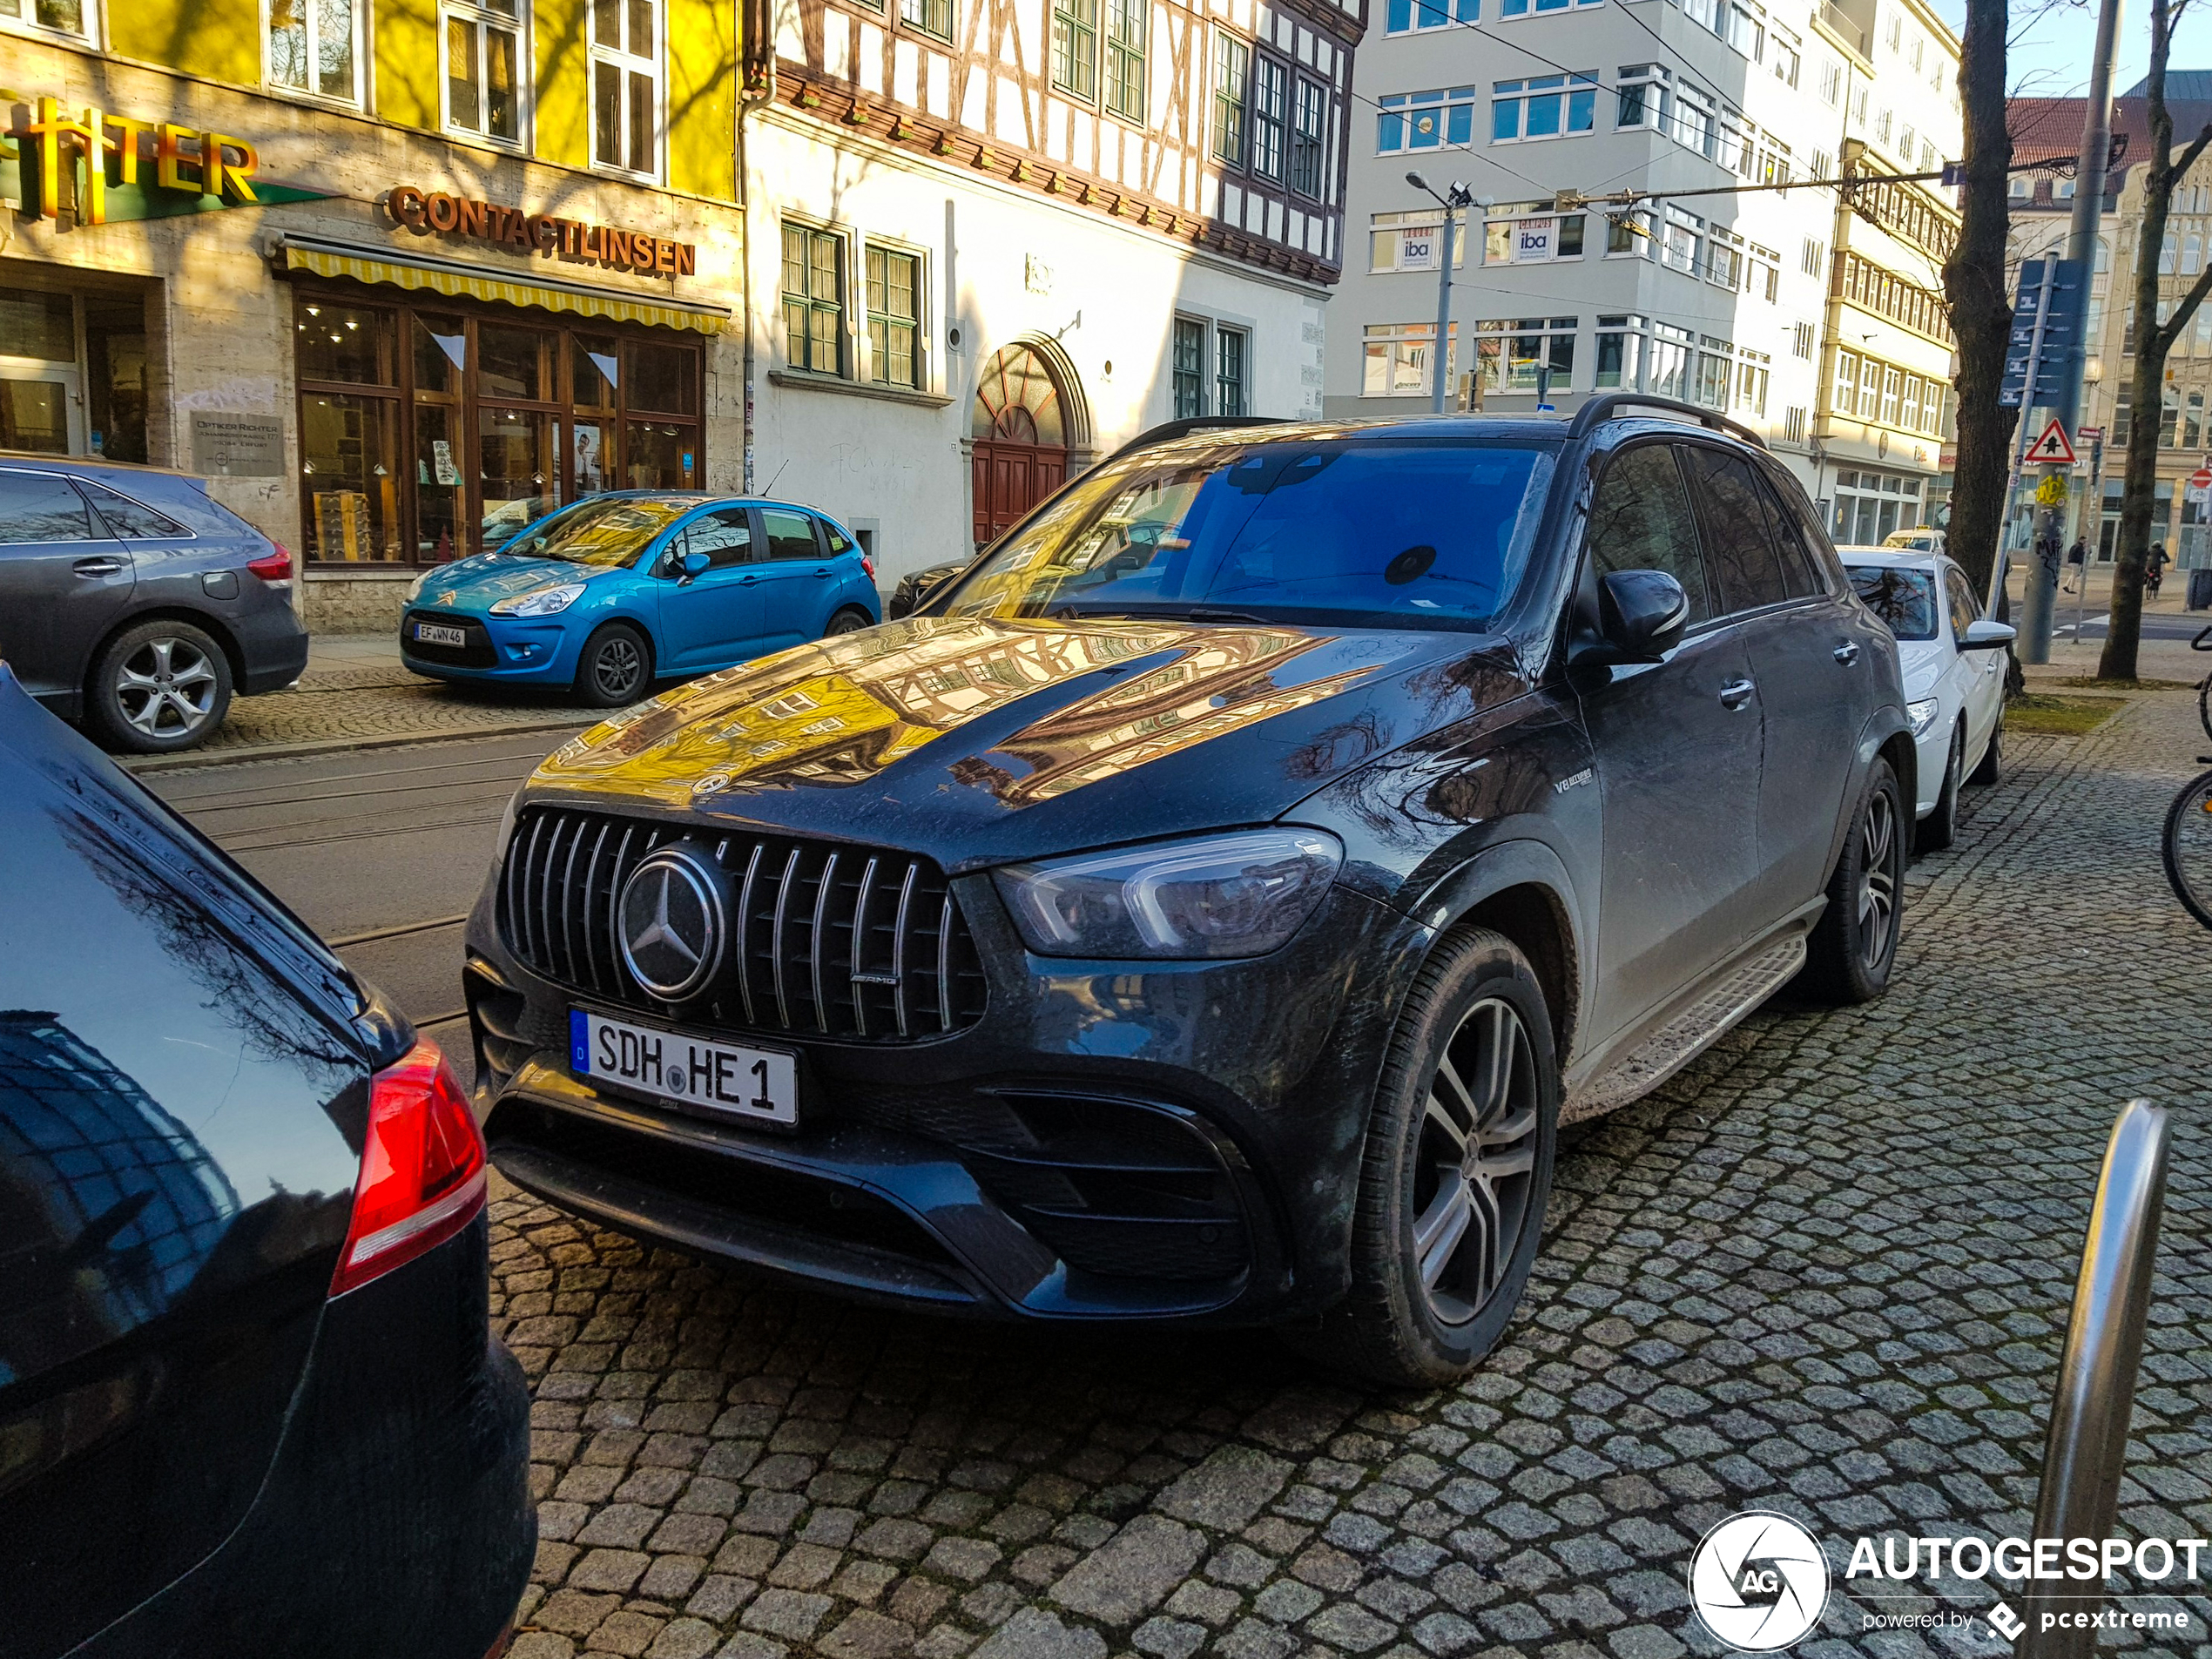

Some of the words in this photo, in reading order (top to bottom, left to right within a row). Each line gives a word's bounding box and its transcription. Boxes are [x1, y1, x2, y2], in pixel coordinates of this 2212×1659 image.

[388, 185, 695, 276] CONTACTLINSEN
[1520, 219, 1551, 229] CAMPUS
[1404, 227, 1433, 238] NEUER
[1405, 240, 1429, 257] iba
[1521, 233, 1547, 249] iba
[197, 421, 237, 430] OPTIKER
[239, 423, 278, 433] RICHTER
[421, 626, 433, 638] EF
[437, 629, 448, 642] WN
[449, 631, 461, 643] 46
[1554, 779, 1570, 794] V8
[865, 976, 897, 985] AMG
[577, 1047, 584, 1061] D
[598, 1024, 662, 1086] SDH
[689, 1046, 739, 1104] HE
[751, 1059, 774, 1110] 1
